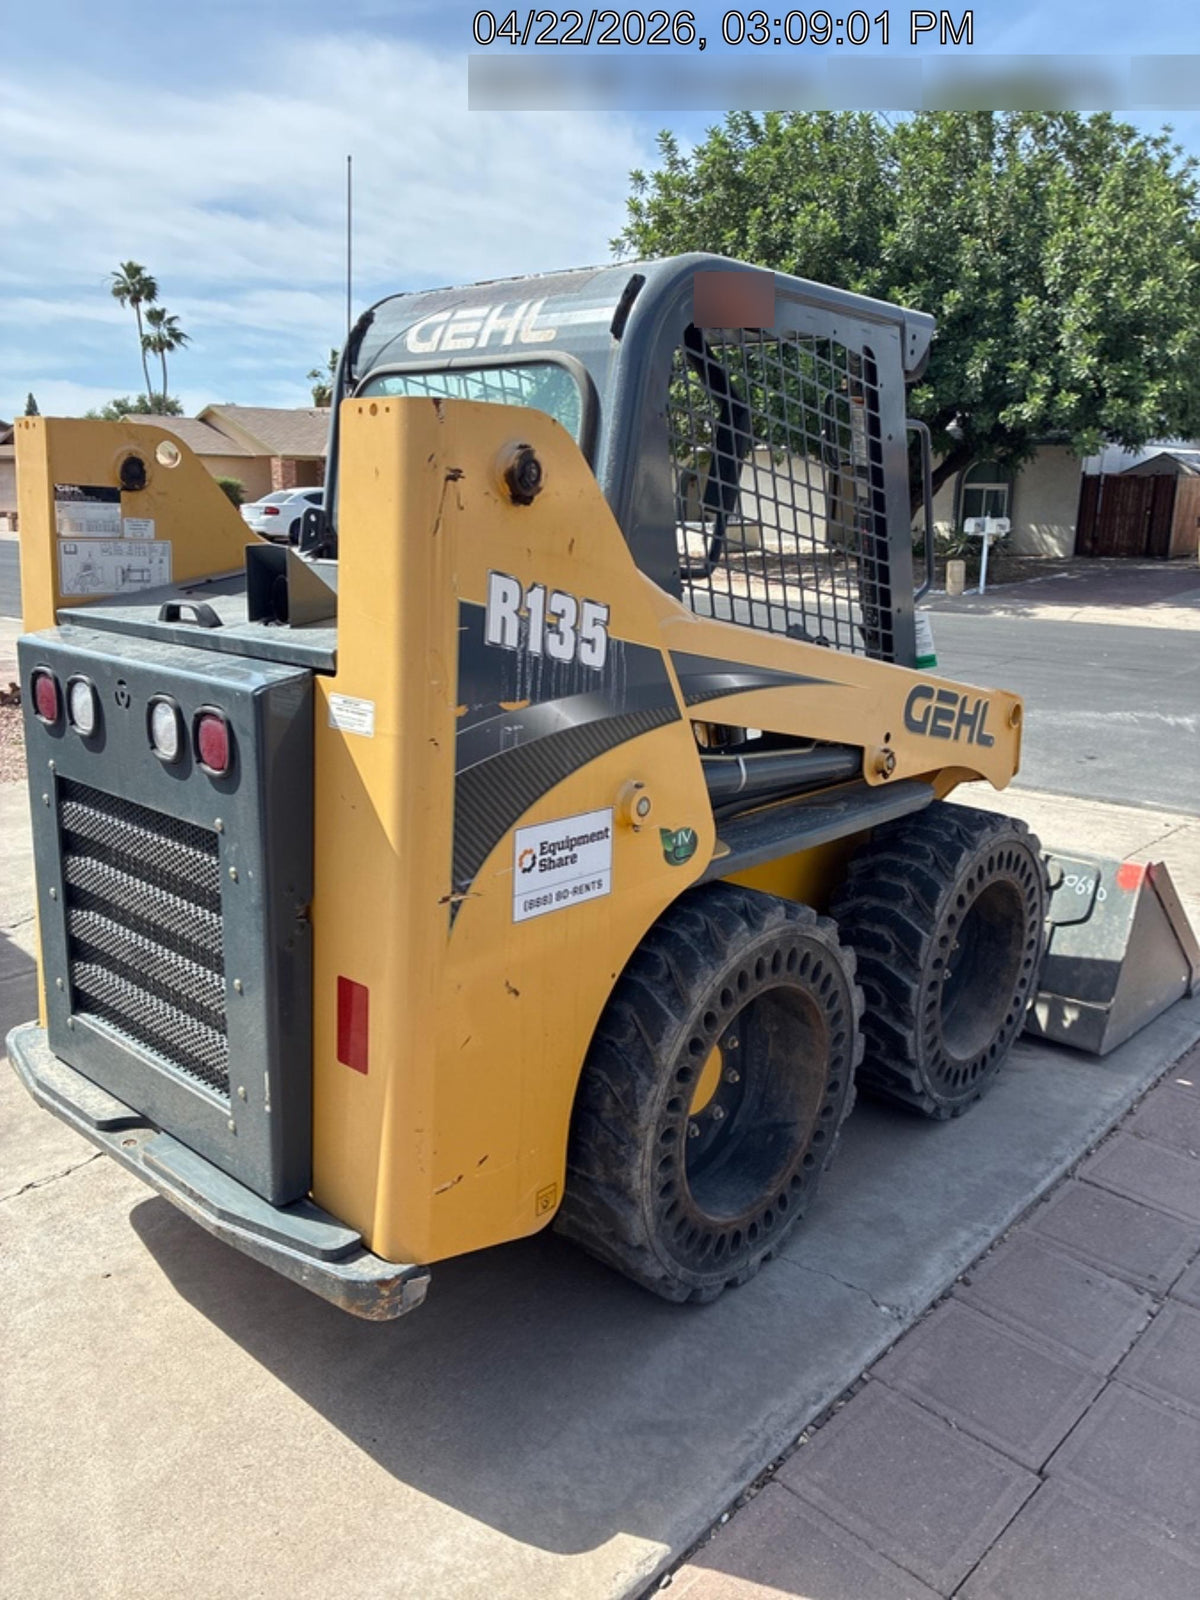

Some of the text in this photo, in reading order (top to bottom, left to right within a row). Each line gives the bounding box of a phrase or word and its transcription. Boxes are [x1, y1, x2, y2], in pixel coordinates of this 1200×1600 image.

[406, 298, 557, 353] GEHL
[485, 570, 610, 671] R135
[904, 684, 995, 748] GEHL
[538, 853, 578, 873] Share
[539, 827, 610, 857] Equipment
[523, 893, 553, 912] (888)
